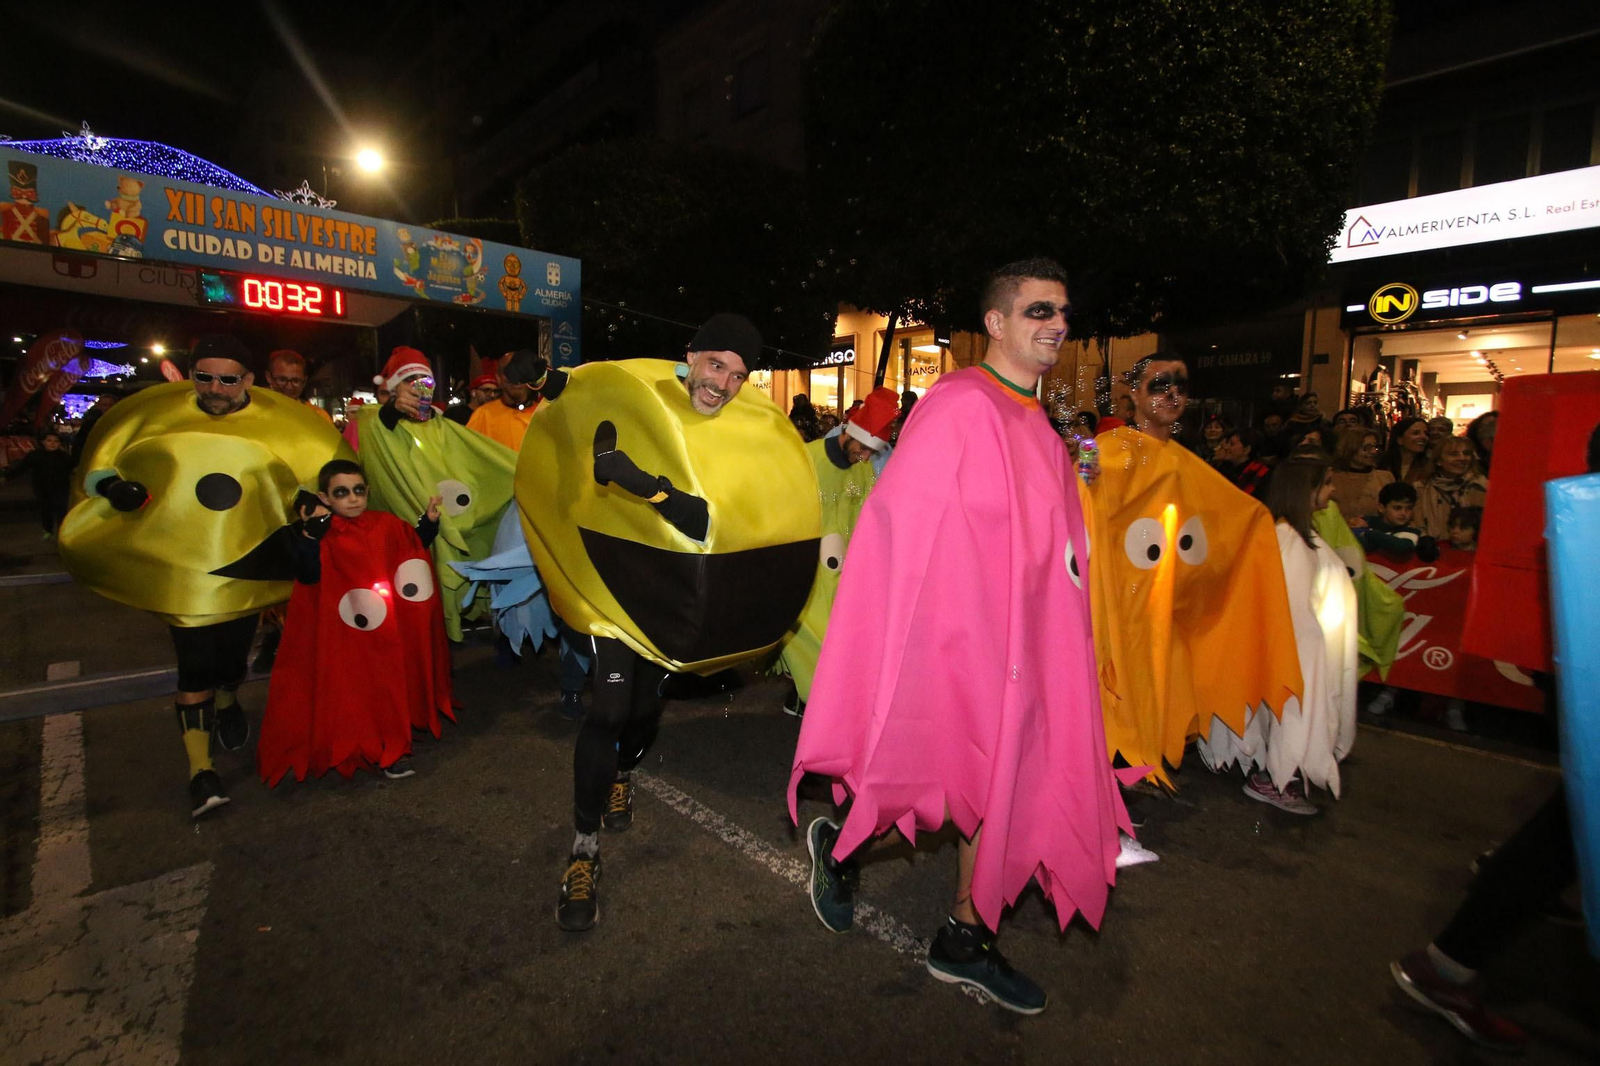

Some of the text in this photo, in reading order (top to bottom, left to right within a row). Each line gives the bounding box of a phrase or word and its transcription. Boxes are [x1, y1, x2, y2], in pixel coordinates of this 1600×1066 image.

[164, 187, 377, 256] XII SAN SILVESTRE
[1386, 211, 1501, 239] ALMERIVENTA
[1508, 206, 1536, 221] S.L.
[1546, 201, 1575, 215] Real
[1580, 198, 1600, 210] Est
[163, 229, 378, 281] CIUDAD DE ALMERÍA
[138, 267, 196, 290] CIUD
[534, 288, 573, 301] ALMERÍA
[541, 298, 568, 308] CIUDAD
